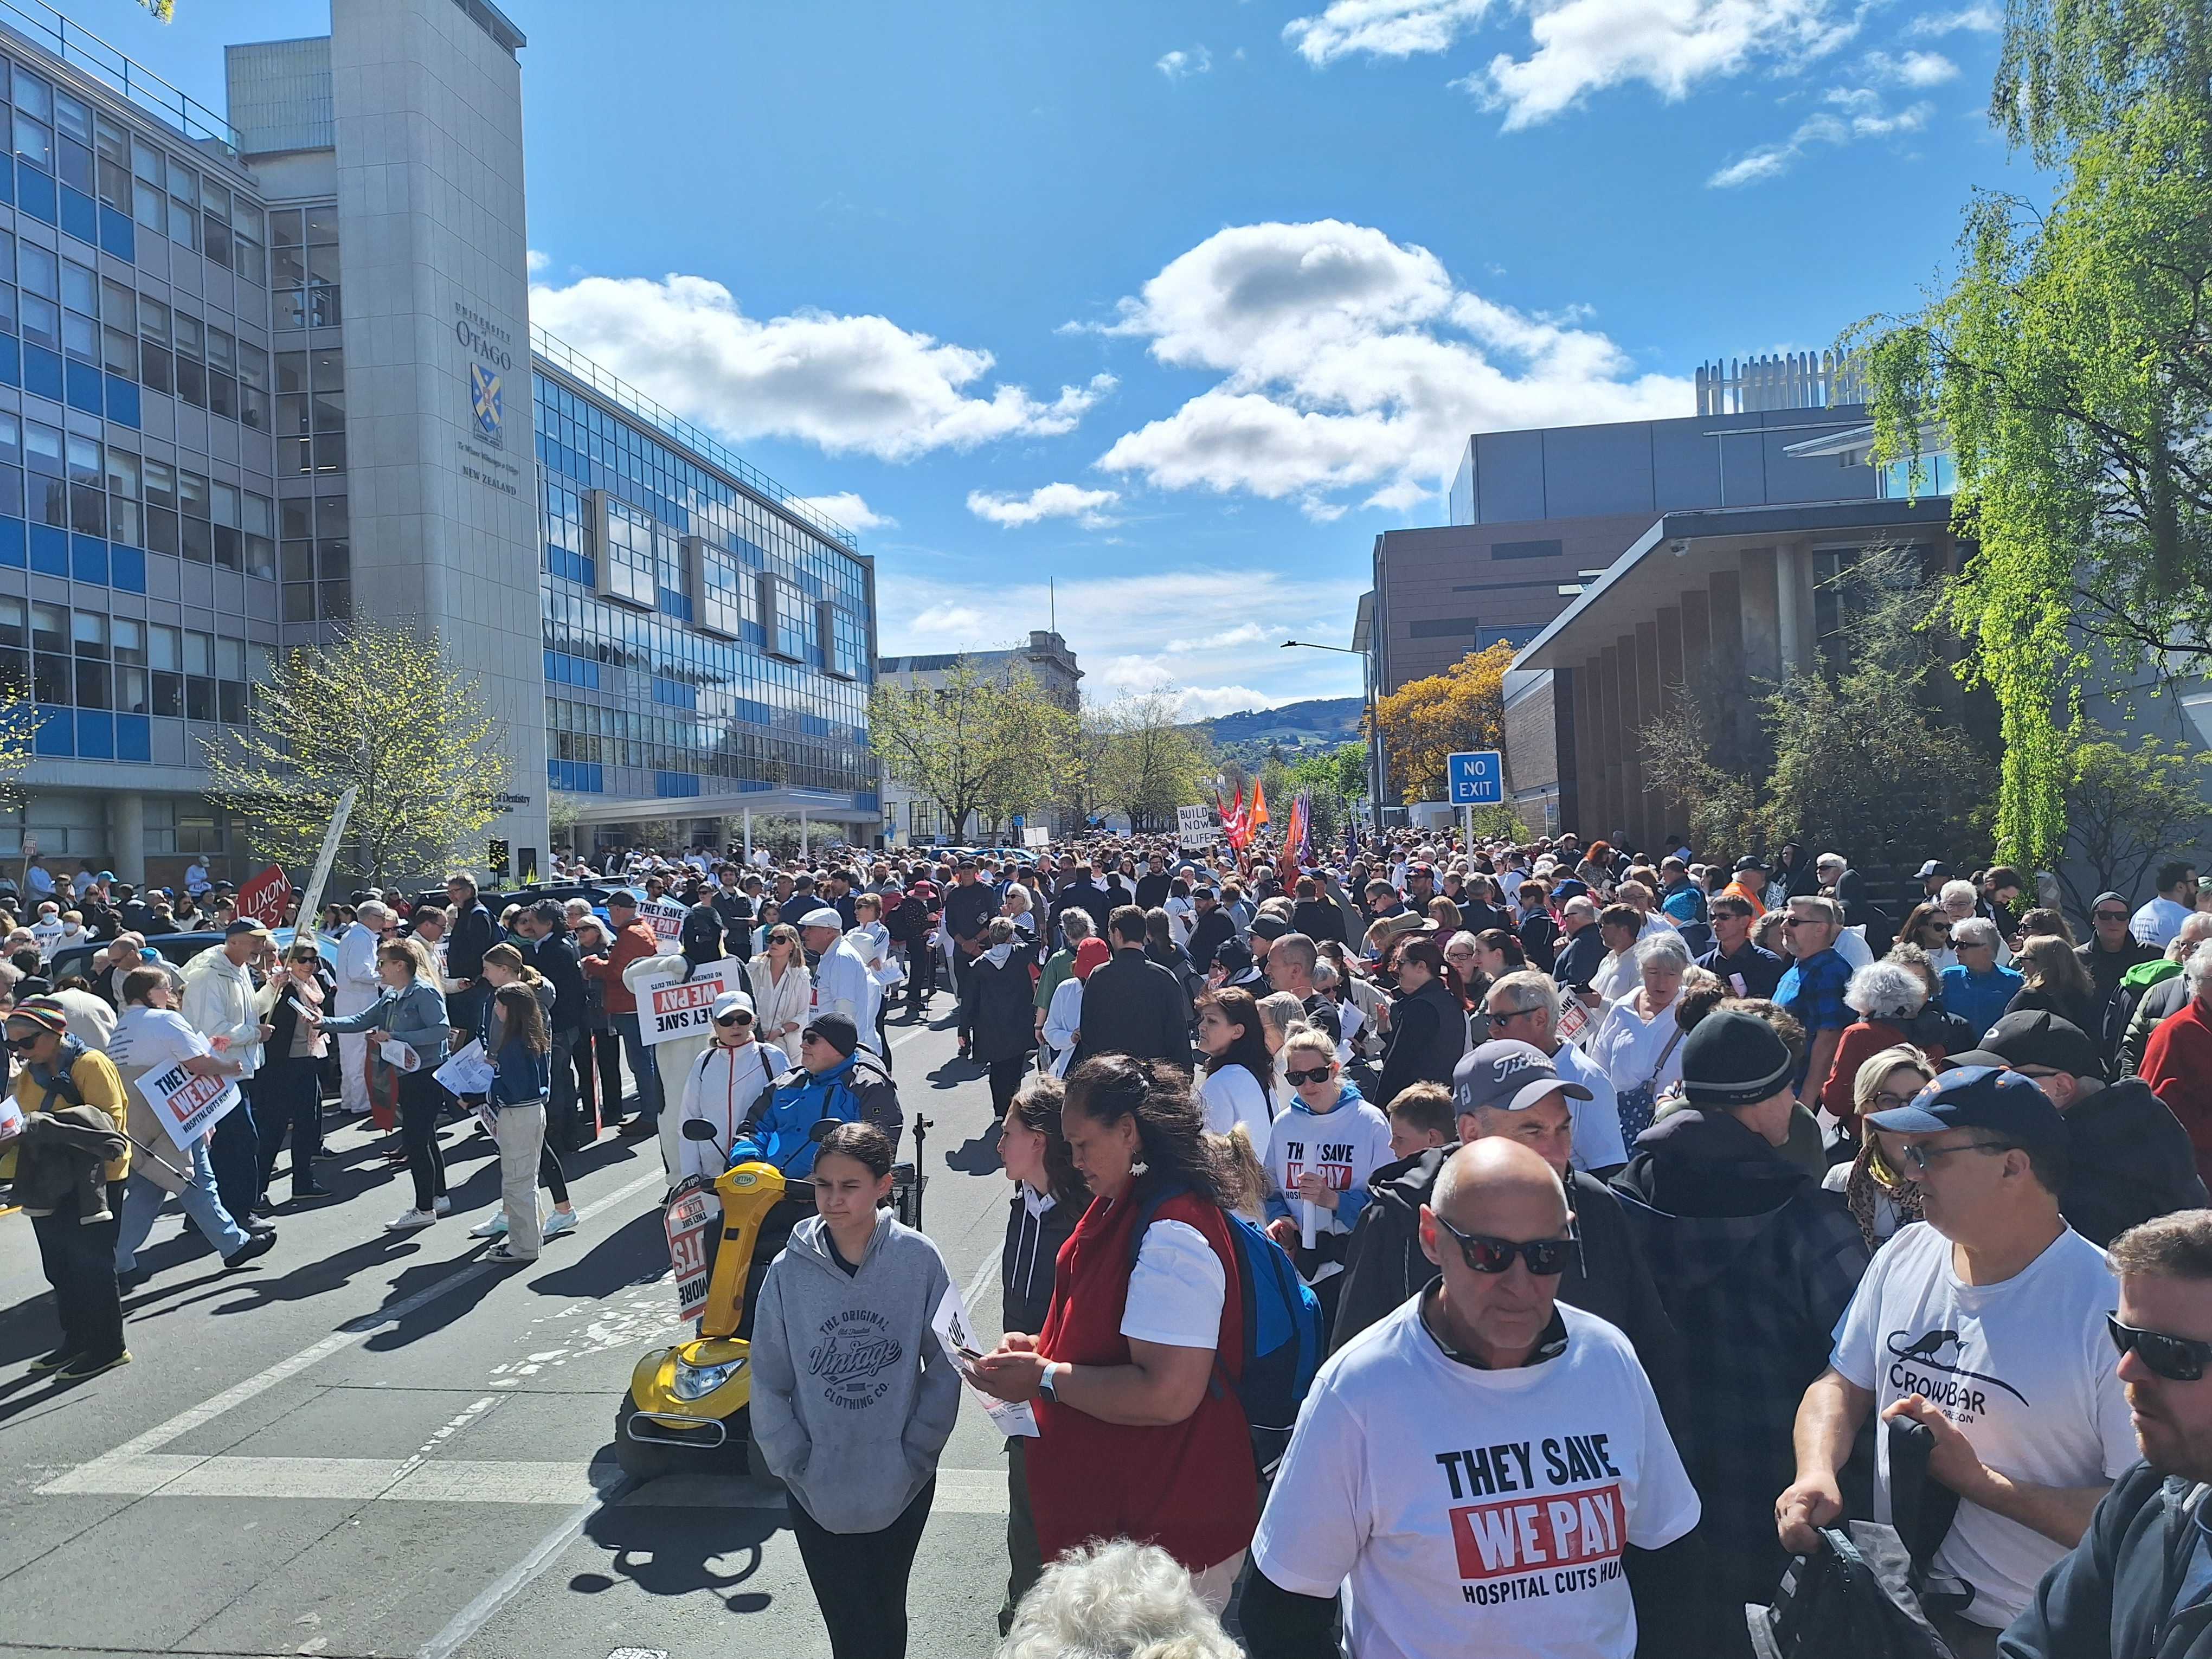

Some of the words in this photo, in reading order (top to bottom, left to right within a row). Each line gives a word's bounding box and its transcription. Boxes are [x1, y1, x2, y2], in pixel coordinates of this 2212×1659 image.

[456, 302, 511, 342] UNIVERSITY
[456, 320, 511, 370] OTAGO
[463, 465, 480, 480] NEW
[482, 474, 517, 496] ZEALAND
[1464, 761, 1486, 776] NO
[503, 793, 531, 807] Dentistry
[1459, 782, 1492, 796] EXIT
[1180, 807, 1207, 819] BUILD
[1185, 820, 1208, 831] NOW
[1182, 833, 1211, 844] 4LIFE
[640, 902, 661, 915] THEY
[662, 907, 684, 919] SAVE
[656, 917, 678, 934] PAY
[651, 982, 665, 991] CUTS
[691, 973, 714, 982] DUNEDIN
[660, 988, 690, 1012] PAY
[690, 983, 718, 1006] WE
[1560, 995, 1576, 1015] SAVE
[655, 1012, 689, 1032] SAVE
[154, 1064, 188, 1096] THEY
[172, 1084, 203, 1116] WE
[182, 1110, 209, 1134] HOSPITAL
[205, 1099, 220, 1115] CUTS
[218, 1089, 230, 1104] HURT
[1321, 1143, 1354, 1162] SAVE
[678, 1276, 709, 1307] MORE
[820, 1316, 840, 1335] THE
[841, 1309, 889, 1332] ORIGINAL
[808, 1336, 902, 1378] Vintage
[824, 1387, 874, 1410] CLOTHING
[874, 1382, 890, 1398] CO.
[1889, 1363, 1985, 1416] CROWBAR
[1942, 1409, 1973, 1424] OREGON
[1435, 1441, 1535, 1500] THEY
[1541, 1433, 1621, 1486] SAVE
[1467, 1504, 1547, 1572] WE
[1546, 1491, 1619, 1561] PAY
[1462, 1575, 1550, 1606] HOSPITAL
[1554, 1567, 1597, 1594] CUTS
